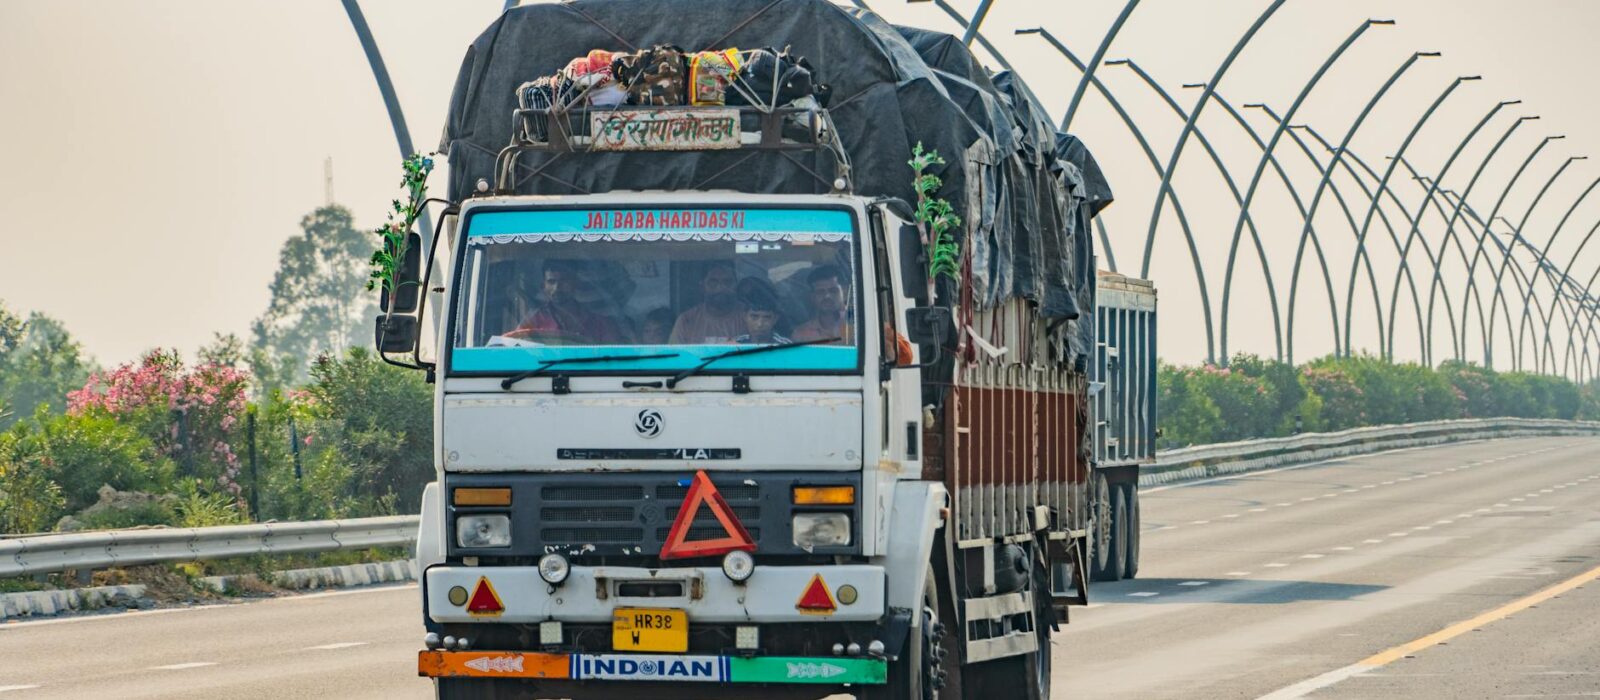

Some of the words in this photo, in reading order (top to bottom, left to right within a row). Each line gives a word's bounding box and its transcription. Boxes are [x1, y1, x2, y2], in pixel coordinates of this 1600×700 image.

[583, 211, 609, 230] JAI
[613, 211, 655, 229] BABA
[659, 211, 728, 229] HARIDAS
[731, 211, 745, 229] KI
[631, 631, 640, 645] W
